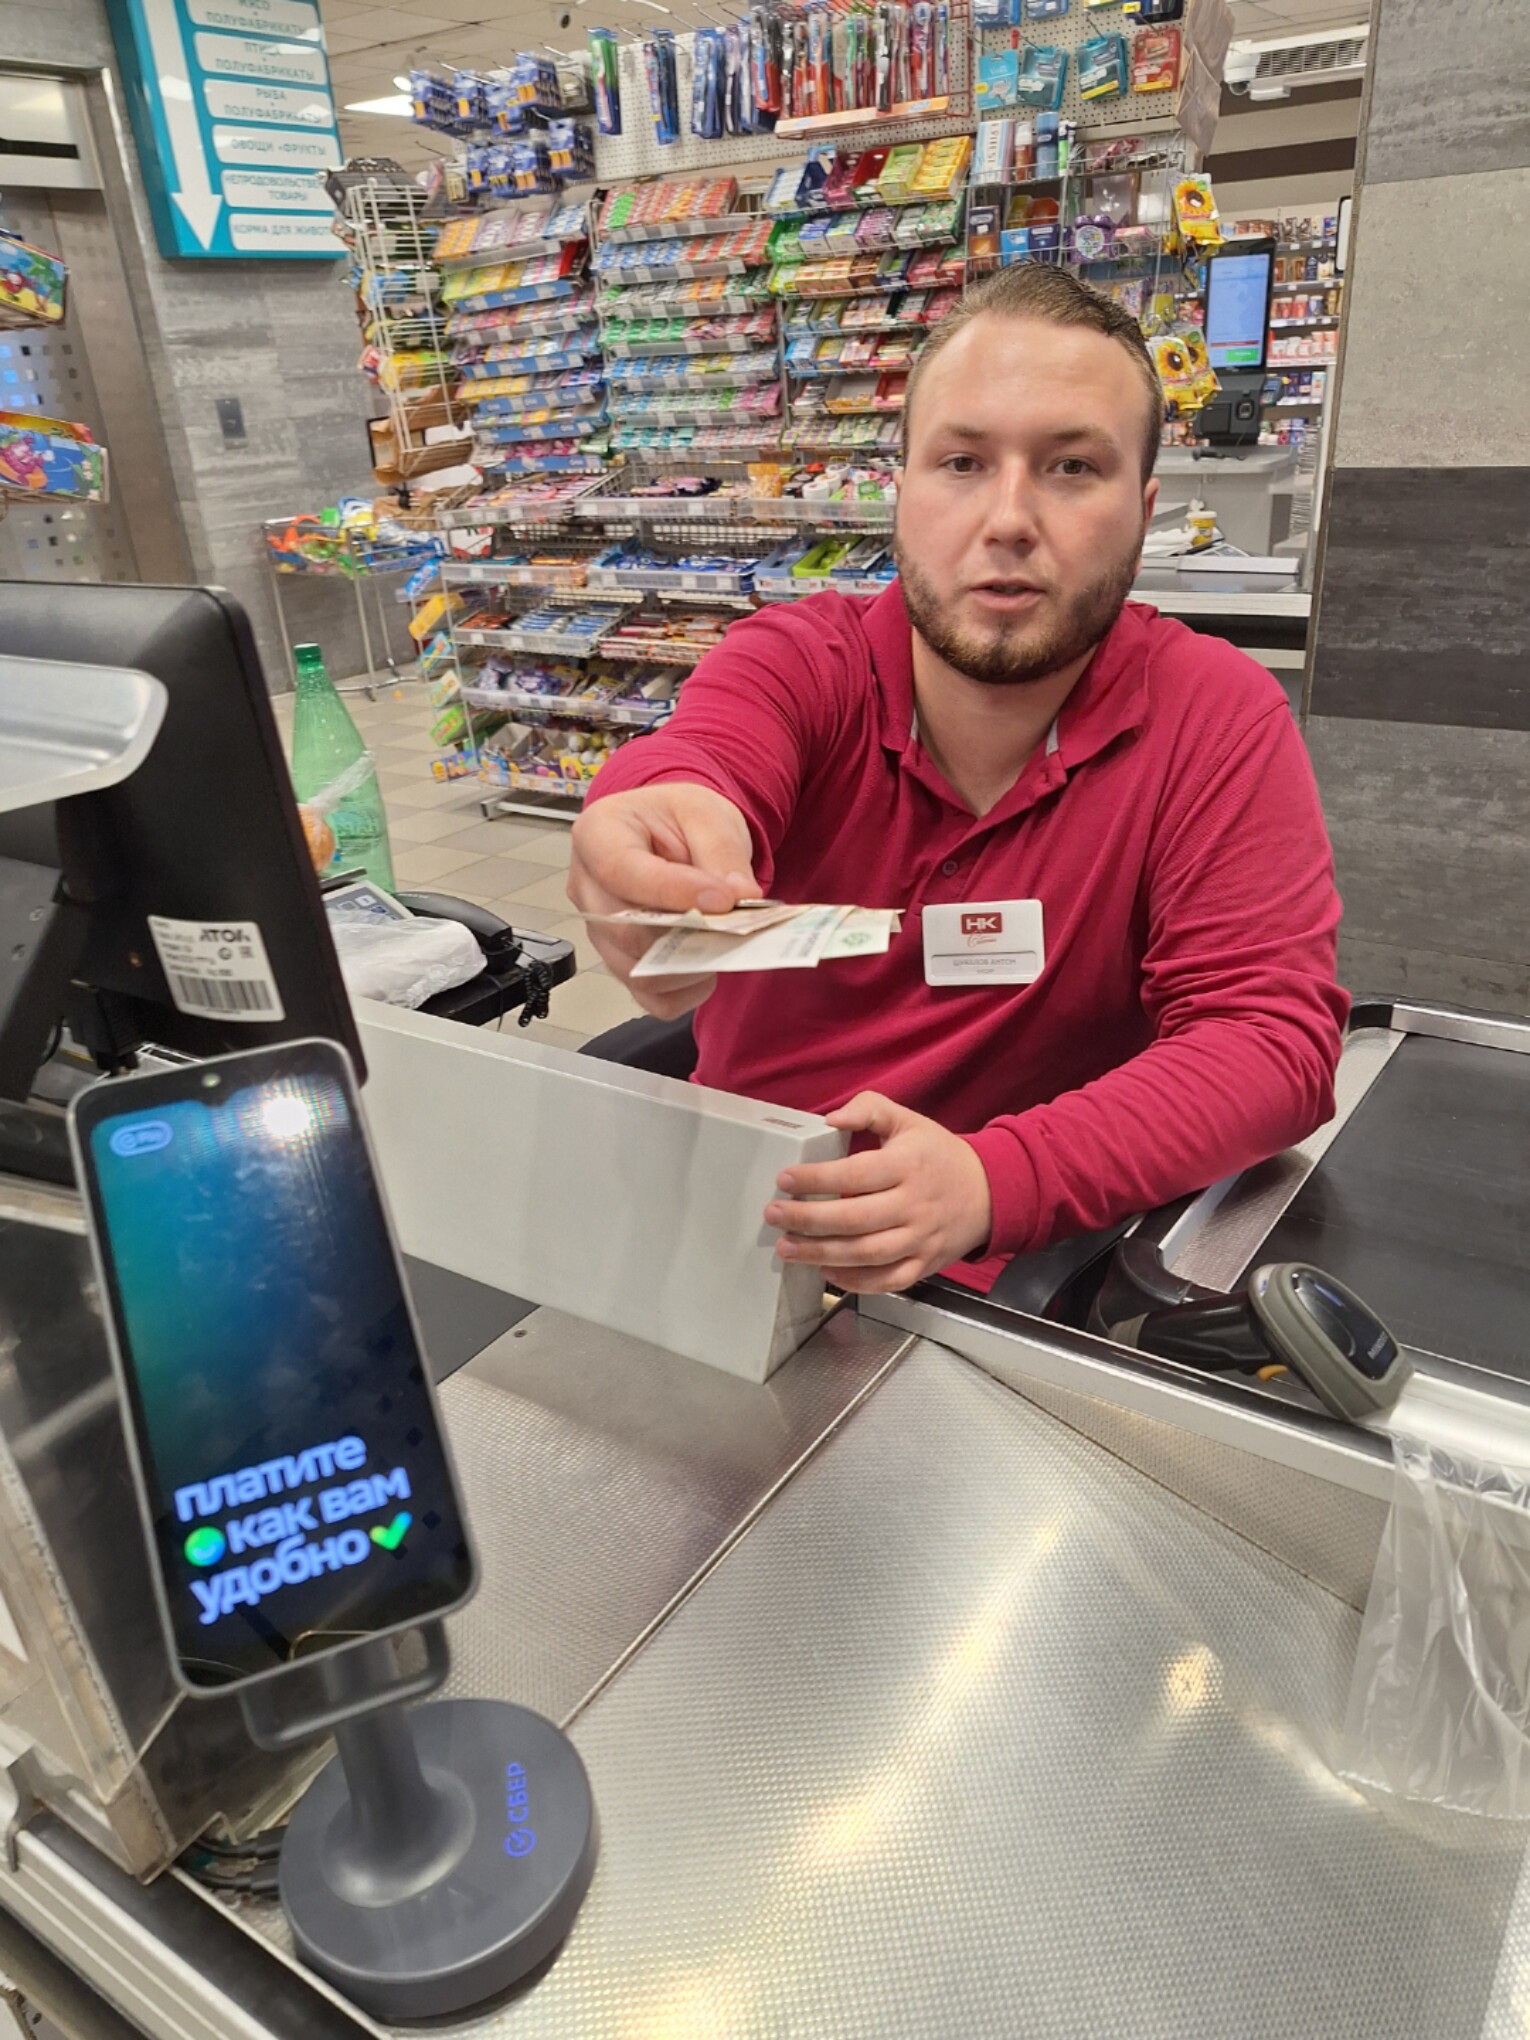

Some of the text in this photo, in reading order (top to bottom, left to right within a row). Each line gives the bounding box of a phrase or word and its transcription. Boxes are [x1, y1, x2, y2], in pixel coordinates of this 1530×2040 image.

[215, 58, 315, 80] ПОЛУФАБРИКАТЫ
[256, 87, 286, 100] РЫБА
[231, 139, 273, 152] ОВОЩИ
[268, 189, 308, 201] ТОВАРЫ
[233, 223, 267, 234] КОРМА
[272, 224, 291, 236] ДЛЯ
[174, 1435, 367, 1522] платите
[226, 1466, 412, 1554] как вам
[188, 1528, 371, 1625] удобно
[506, 1761, 529, 1823] СБЕР
